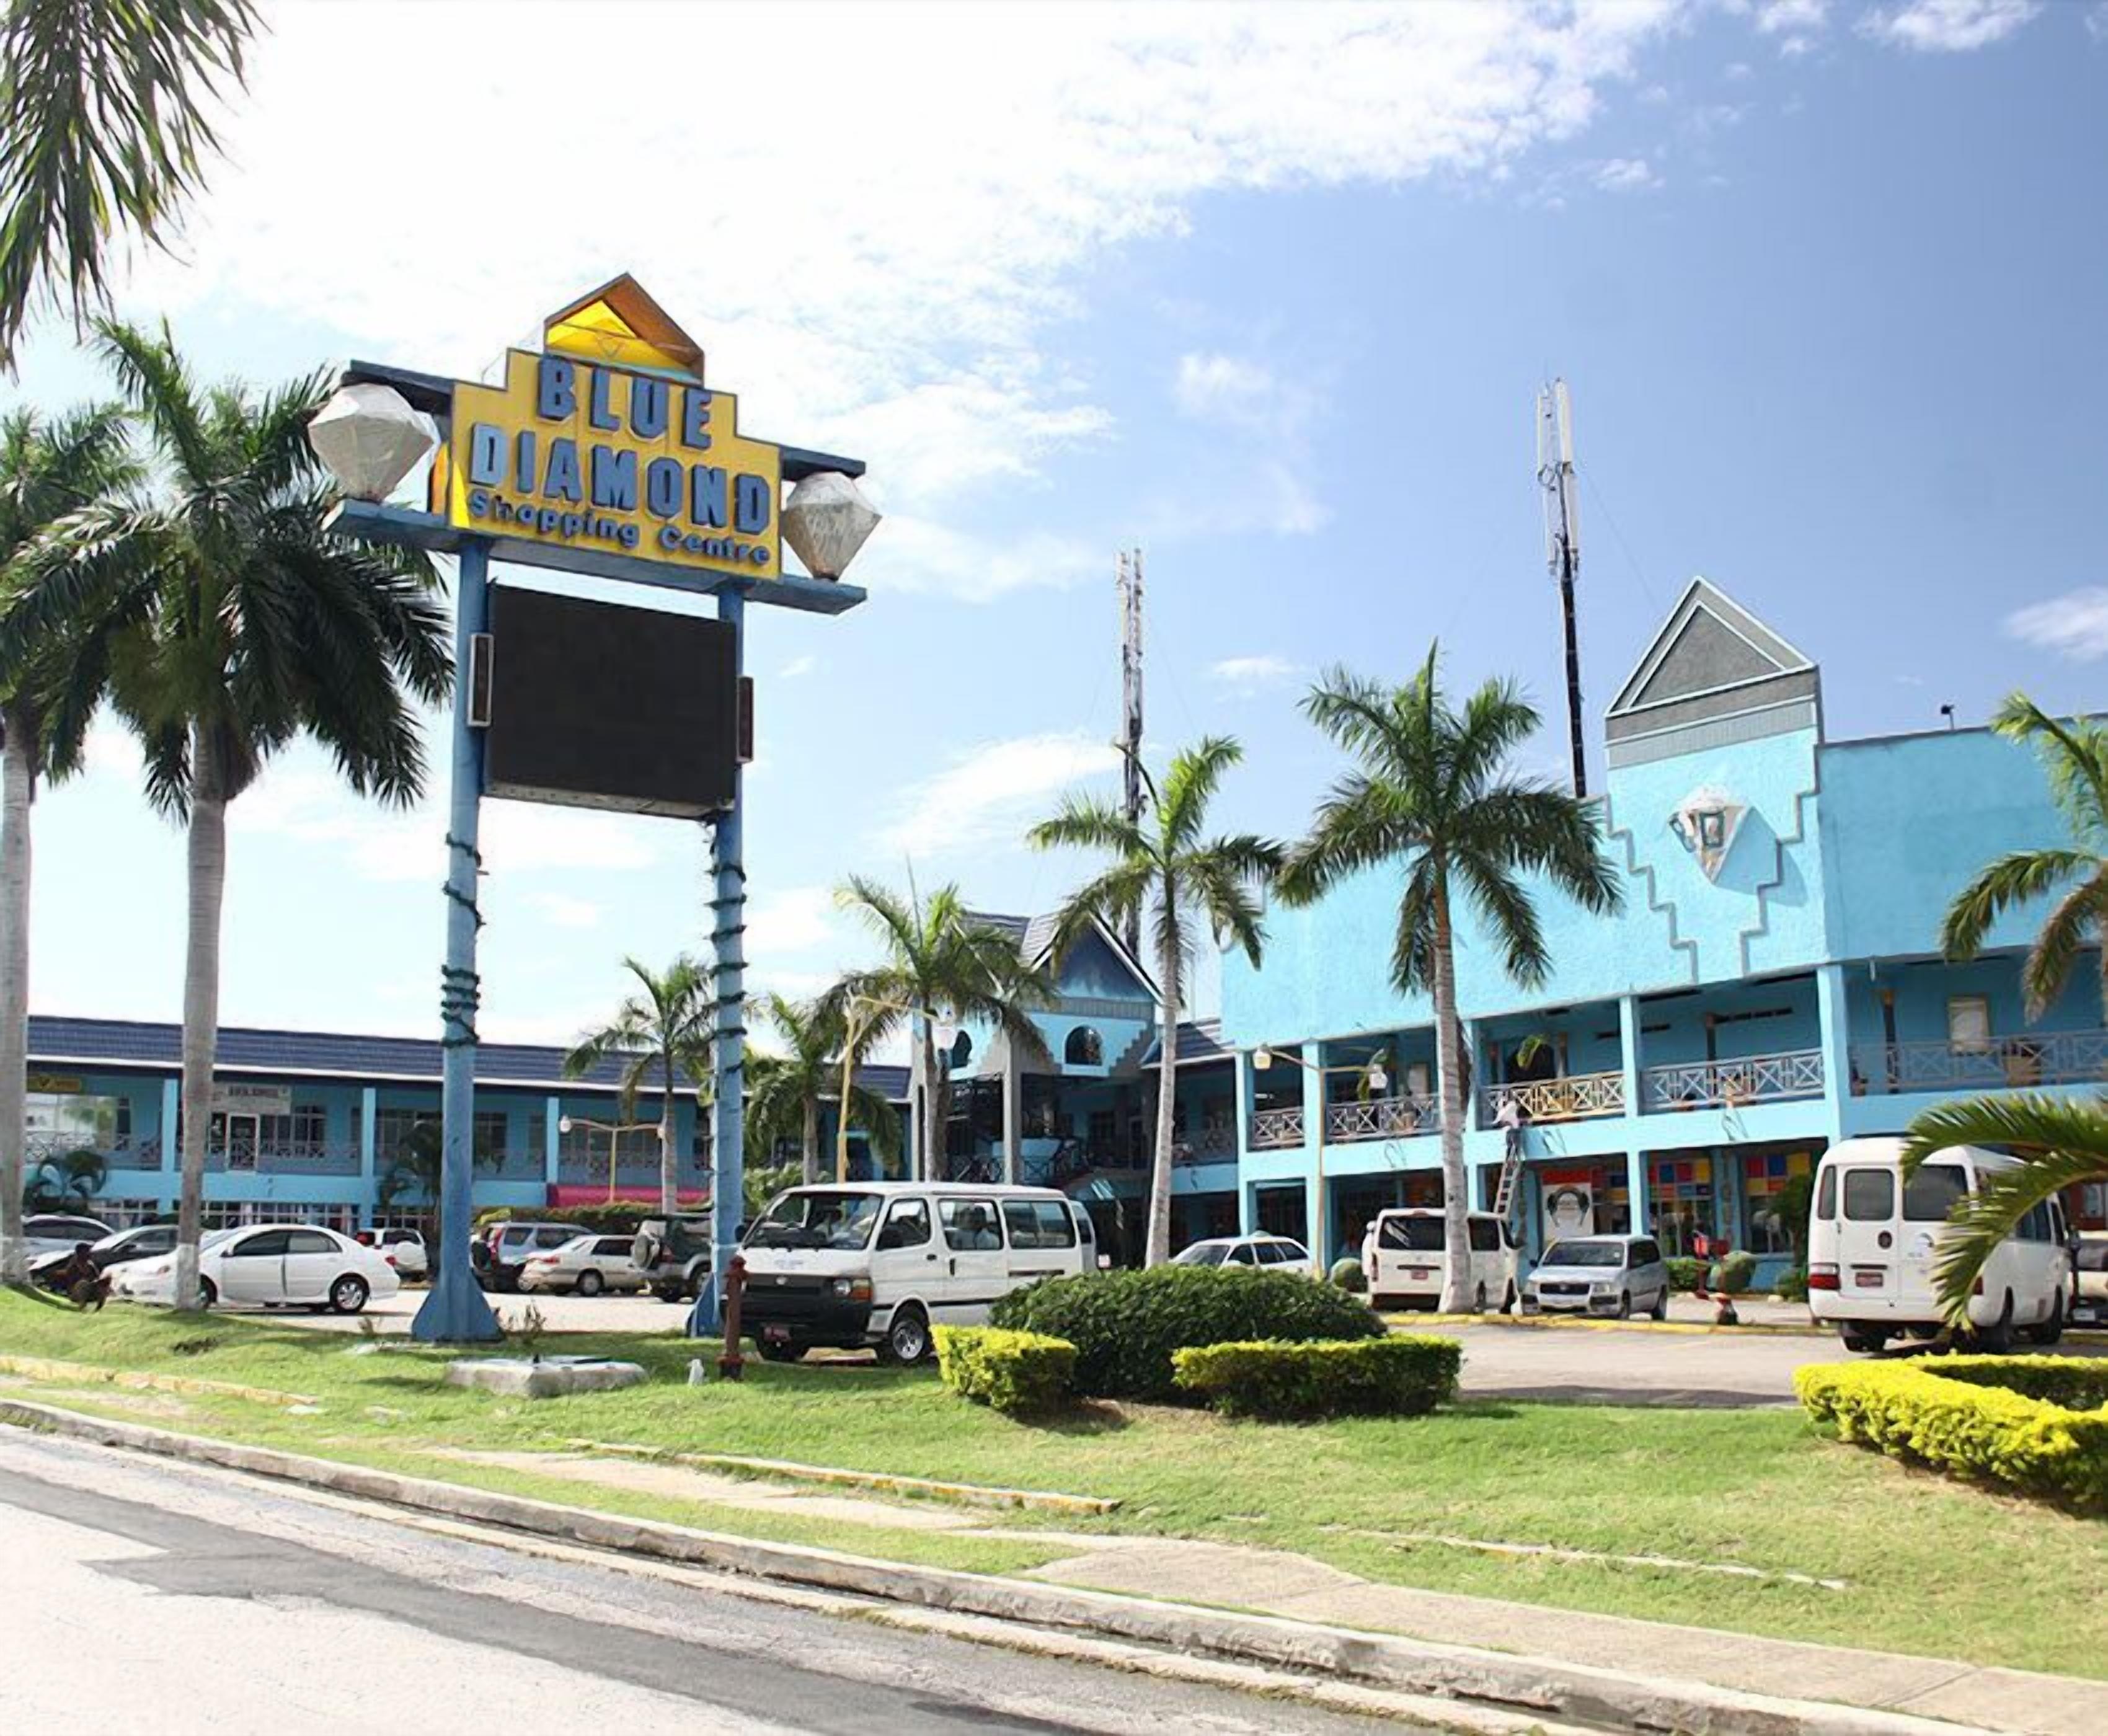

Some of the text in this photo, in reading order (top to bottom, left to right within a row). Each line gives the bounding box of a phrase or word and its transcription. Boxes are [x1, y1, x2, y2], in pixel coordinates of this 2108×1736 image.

[538, 354, 711, 450] BLUE
[469, 423, 771, 534] DIAMOND
[469, 488, 771, 565] Shopping Centre
